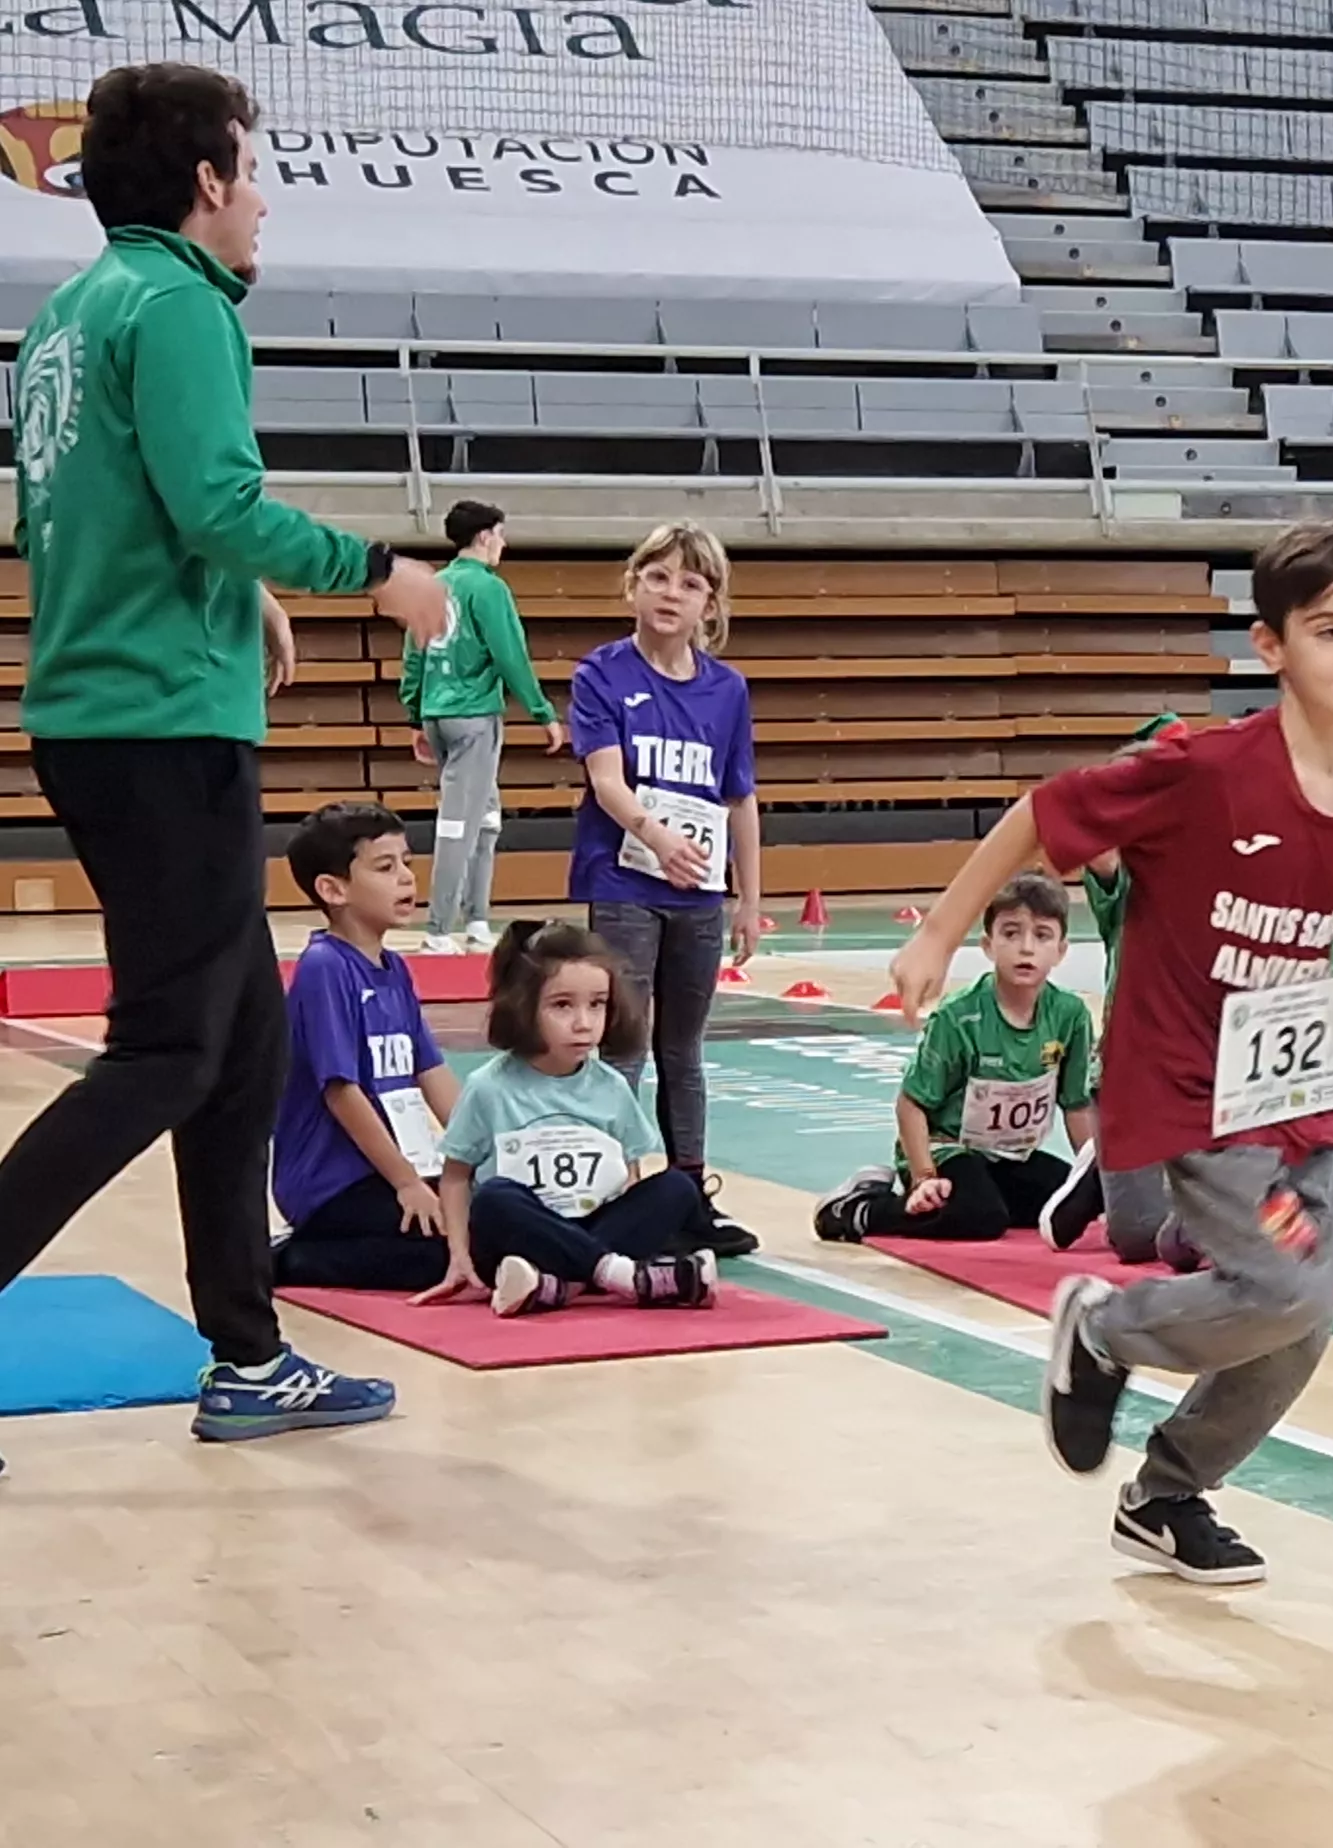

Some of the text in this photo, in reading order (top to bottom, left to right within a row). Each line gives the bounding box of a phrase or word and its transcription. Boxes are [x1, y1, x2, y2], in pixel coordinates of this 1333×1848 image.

[276, 160, 722, 200] HUESCA
[1245, 1019, 1326, 1083] 132
[986, 1093, 1050, 1132] 105
[526, 1151, 603, 1190] 187
